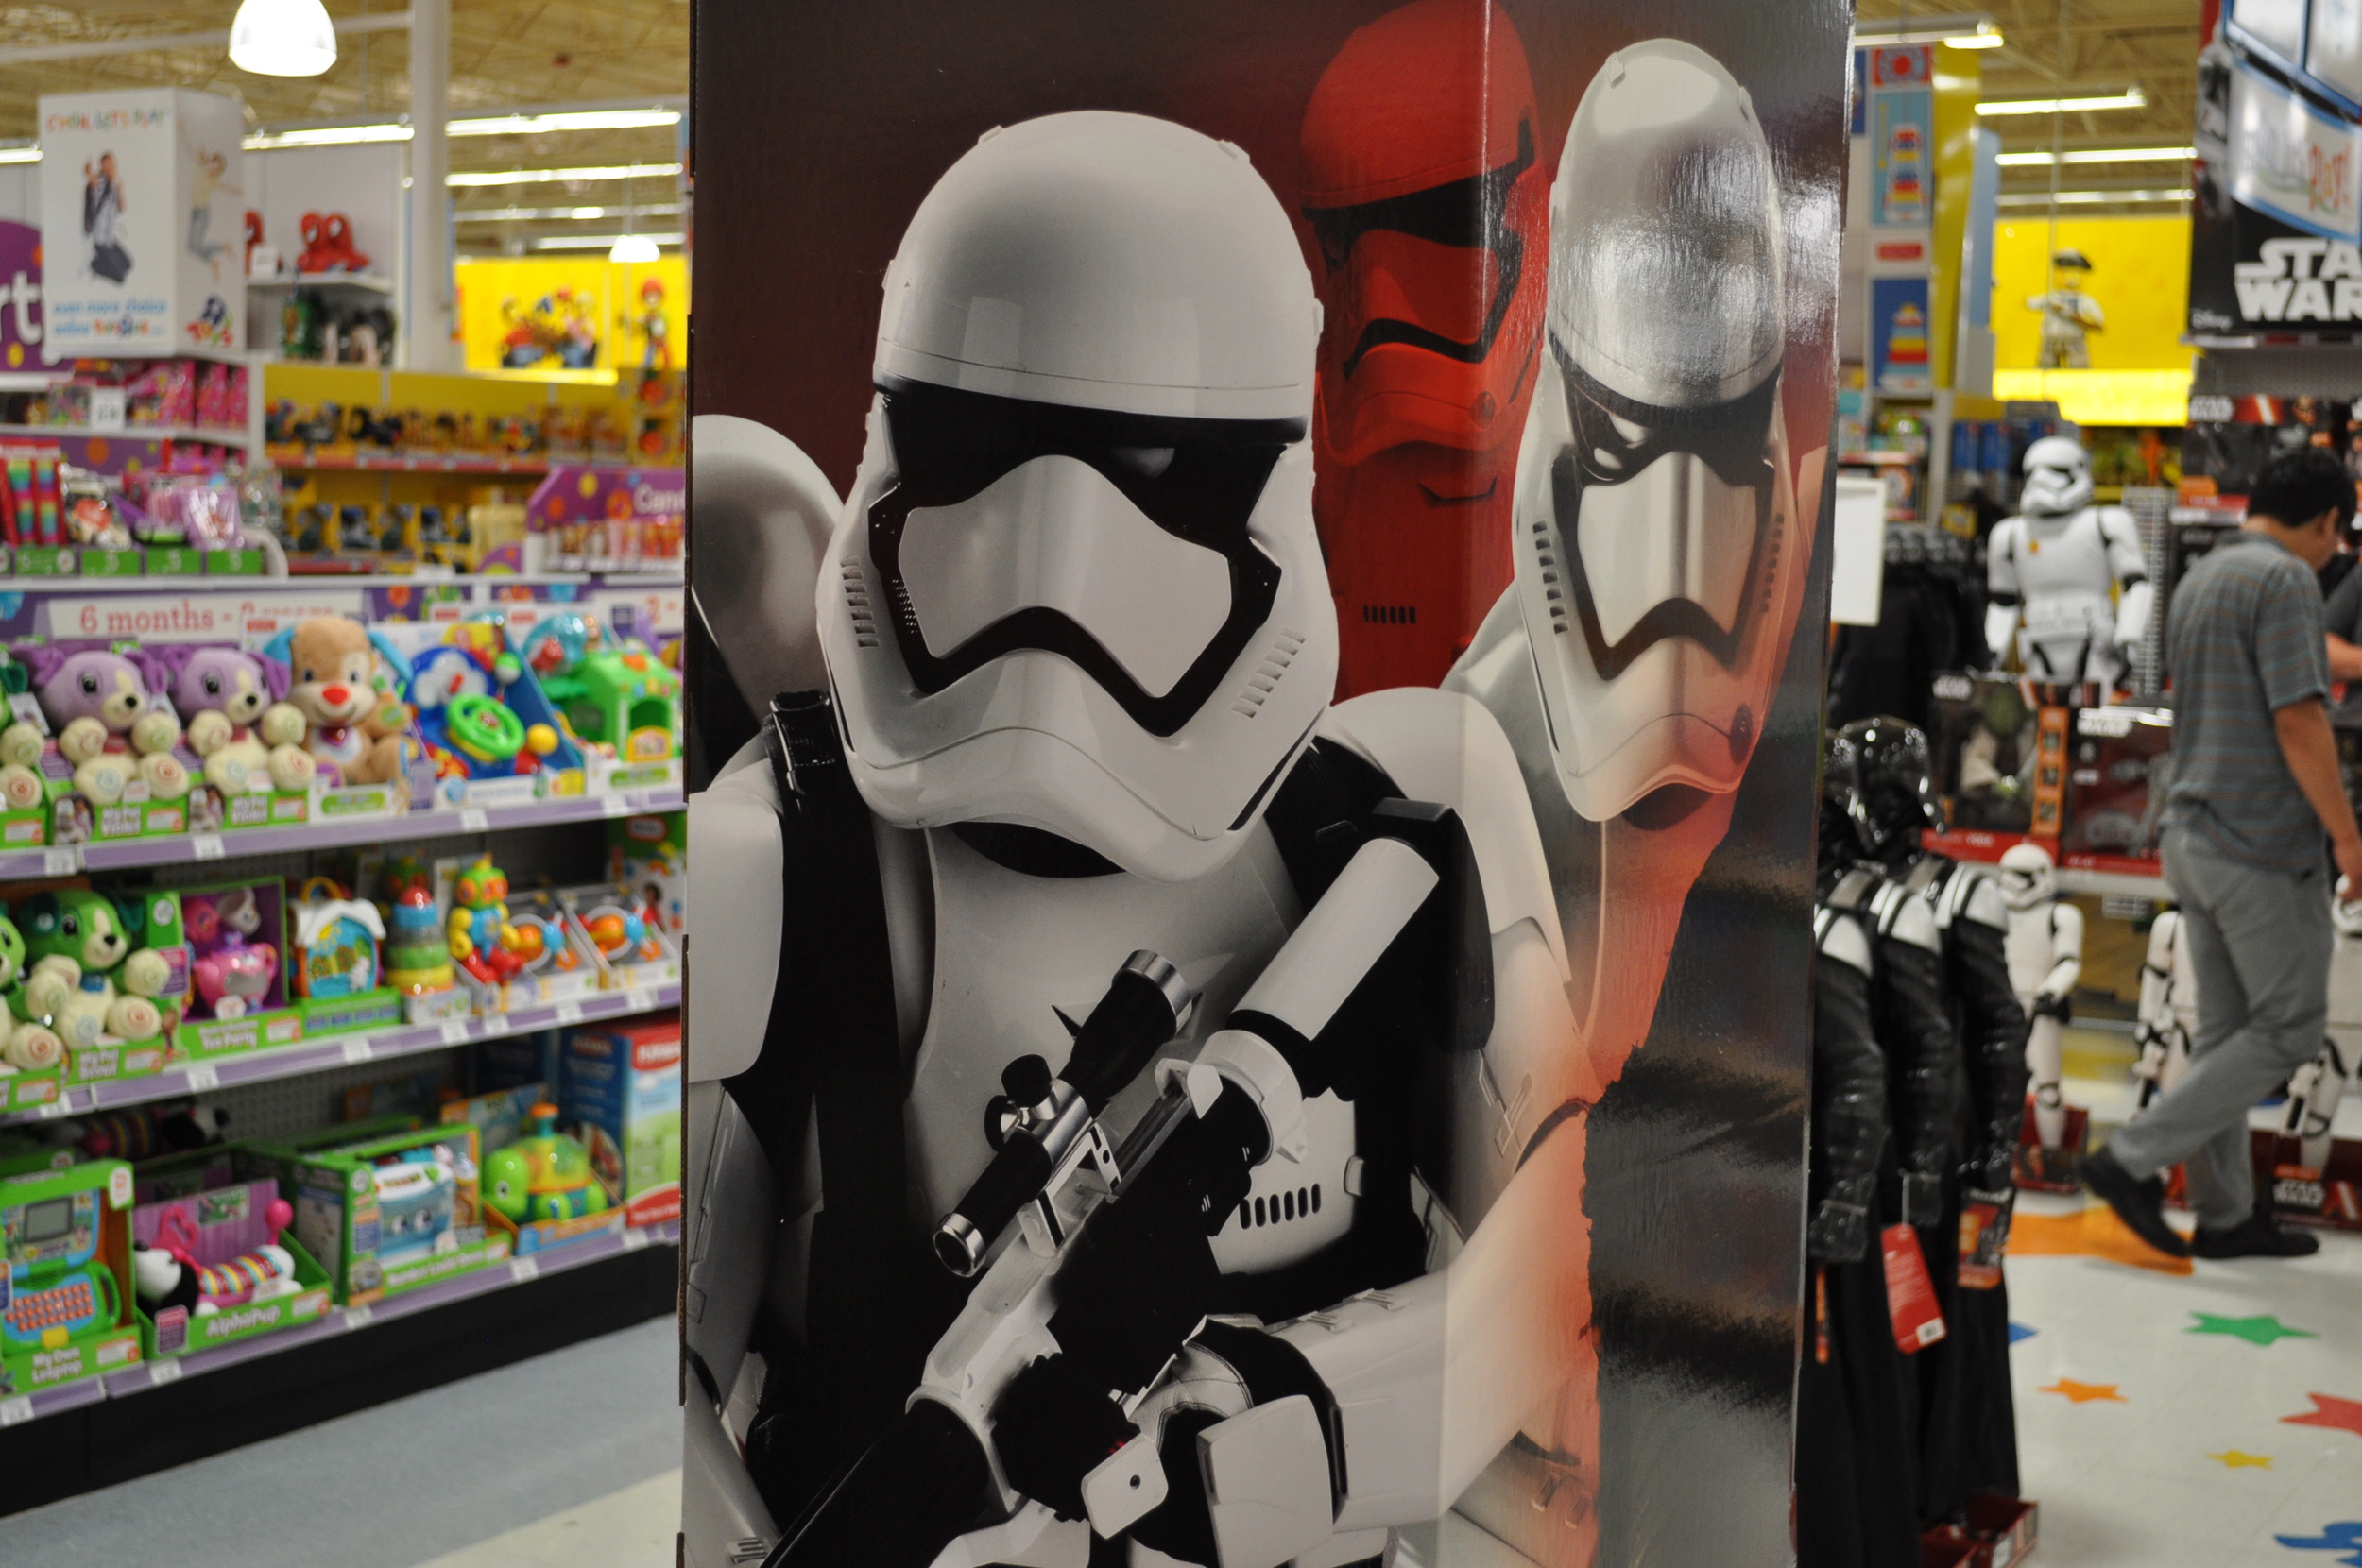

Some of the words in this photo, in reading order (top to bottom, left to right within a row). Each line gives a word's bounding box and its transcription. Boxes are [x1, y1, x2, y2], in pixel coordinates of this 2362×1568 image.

[79, 605, 99, 633] 6
[107, 599, 215, 633] months
[206, 1305, 281, 1338] AlphaPup
